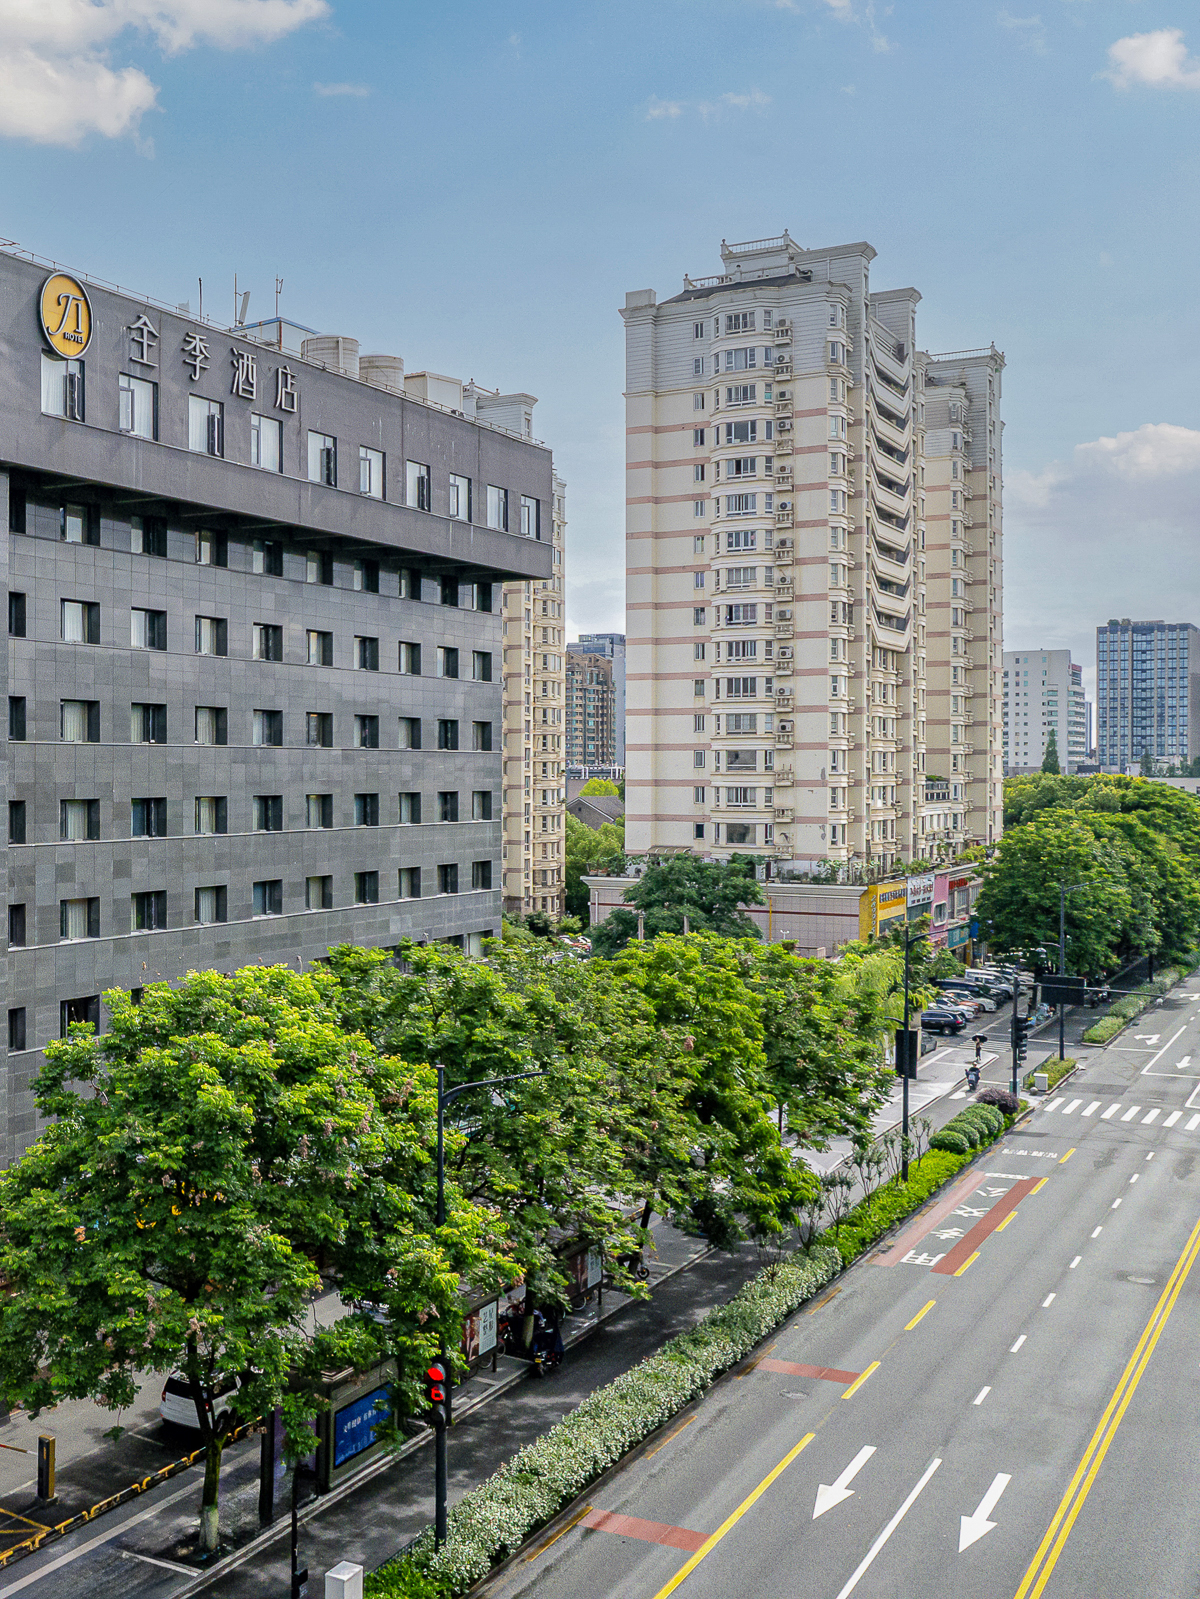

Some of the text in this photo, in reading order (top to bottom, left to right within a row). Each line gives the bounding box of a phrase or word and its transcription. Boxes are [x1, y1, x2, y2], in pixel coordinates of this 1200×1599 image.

[64, 331, 85, 344] HOTEL
[128, 313, 298, 413] 全季酒店
